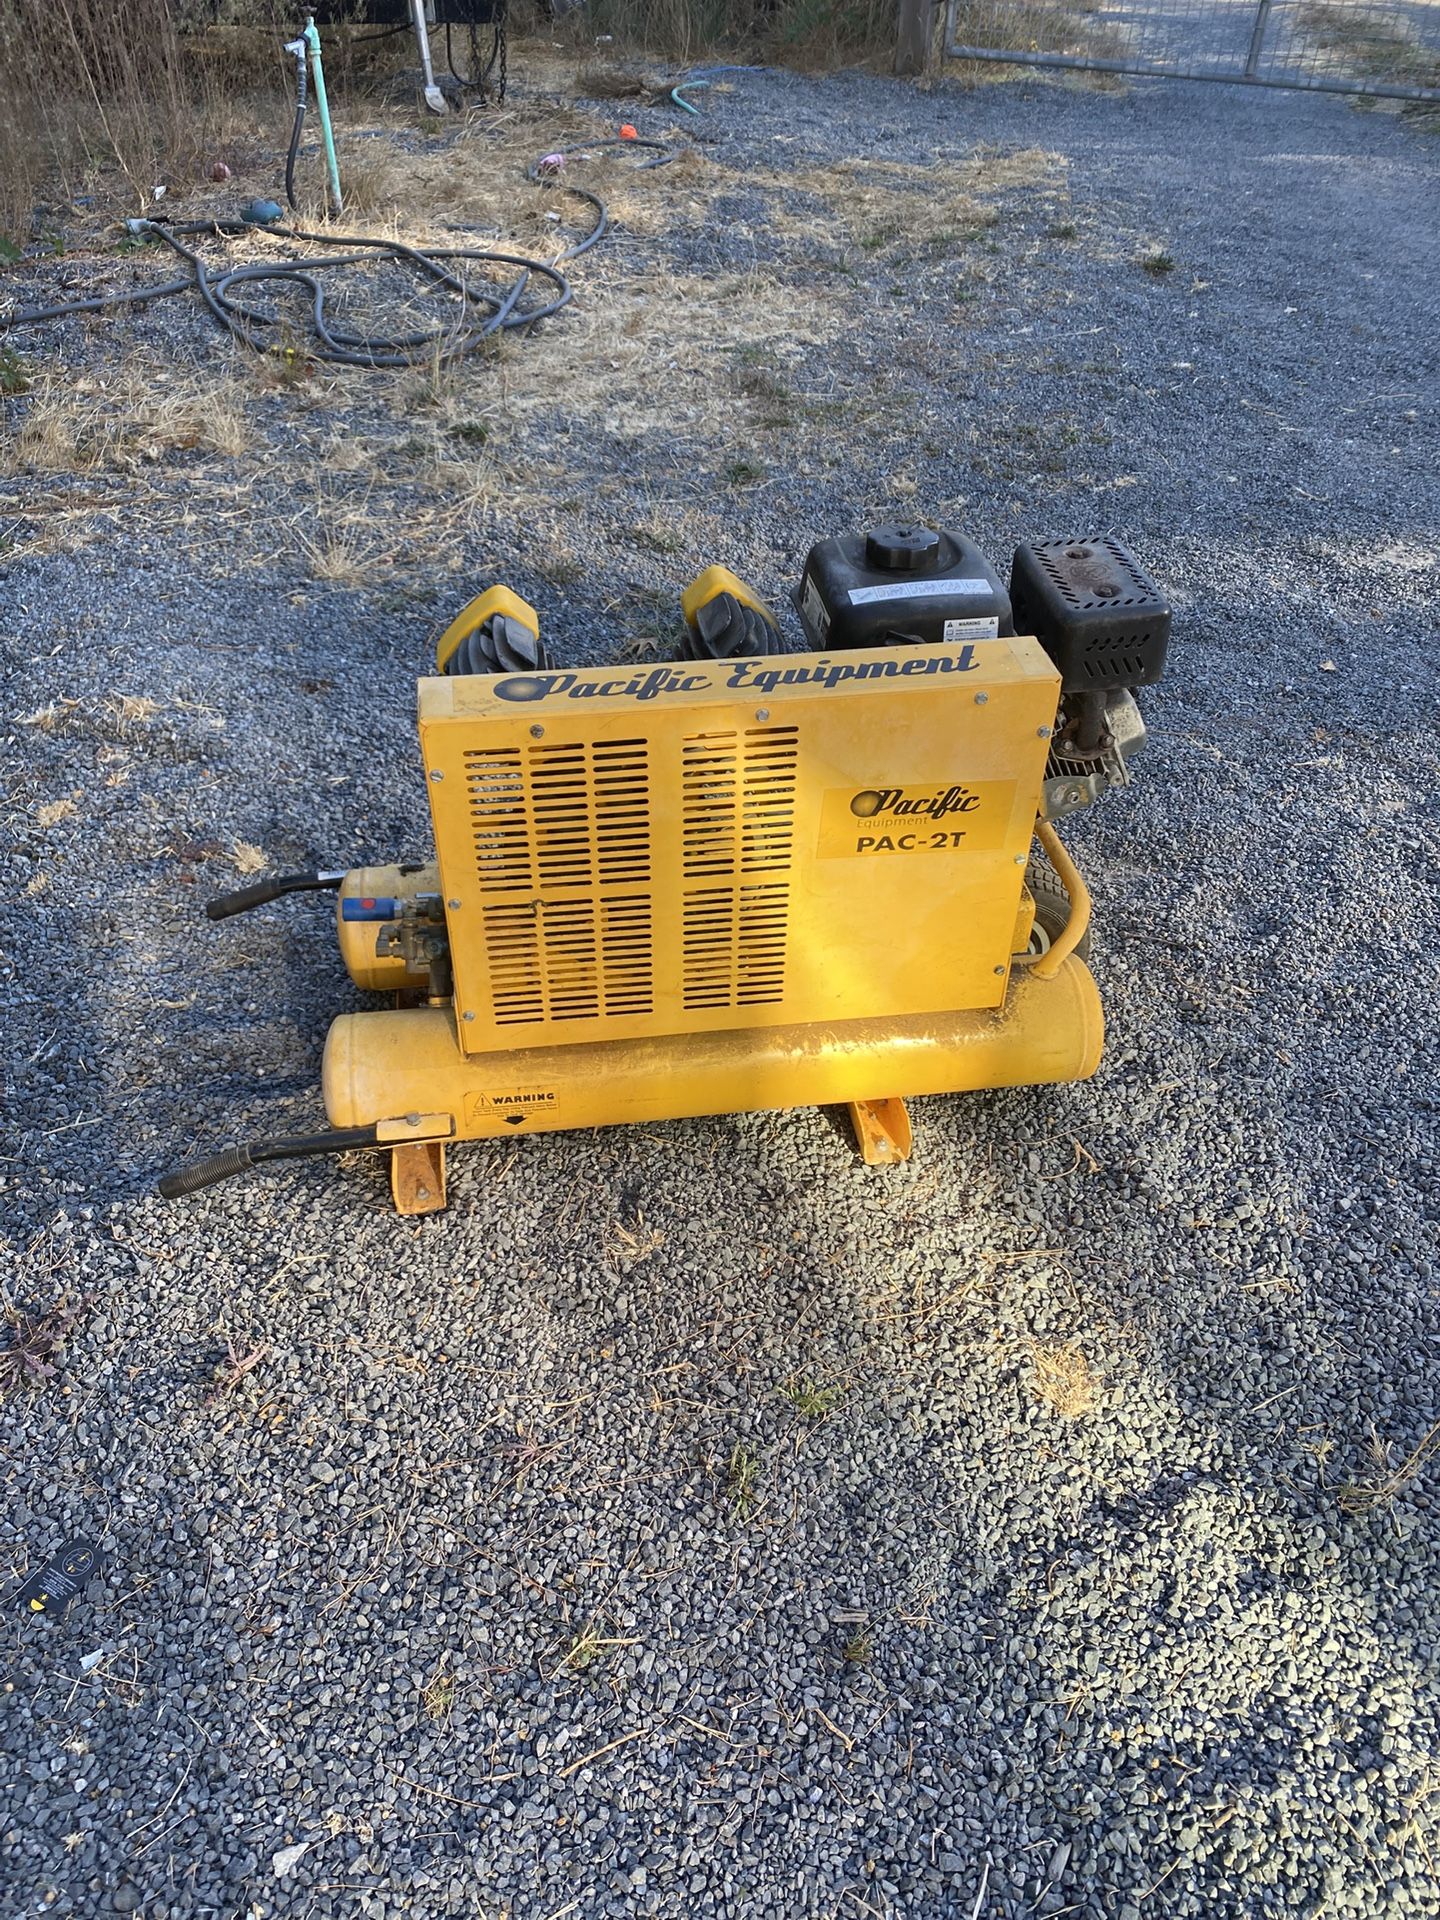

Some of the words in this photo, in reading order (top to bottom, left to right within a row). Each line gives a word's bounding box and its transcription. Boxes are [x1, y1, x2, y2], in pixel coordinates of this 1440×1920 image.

[520, 668, 712, 700] Pacific
[718, 645, 981, 693] Equipment
[868, 786, 980, 819] Pacific
[856, 816, 928, 829] Equipment
[856, 832, 966, 852] PAC-2T
[492, 1092, 555, 1105] WARNING
